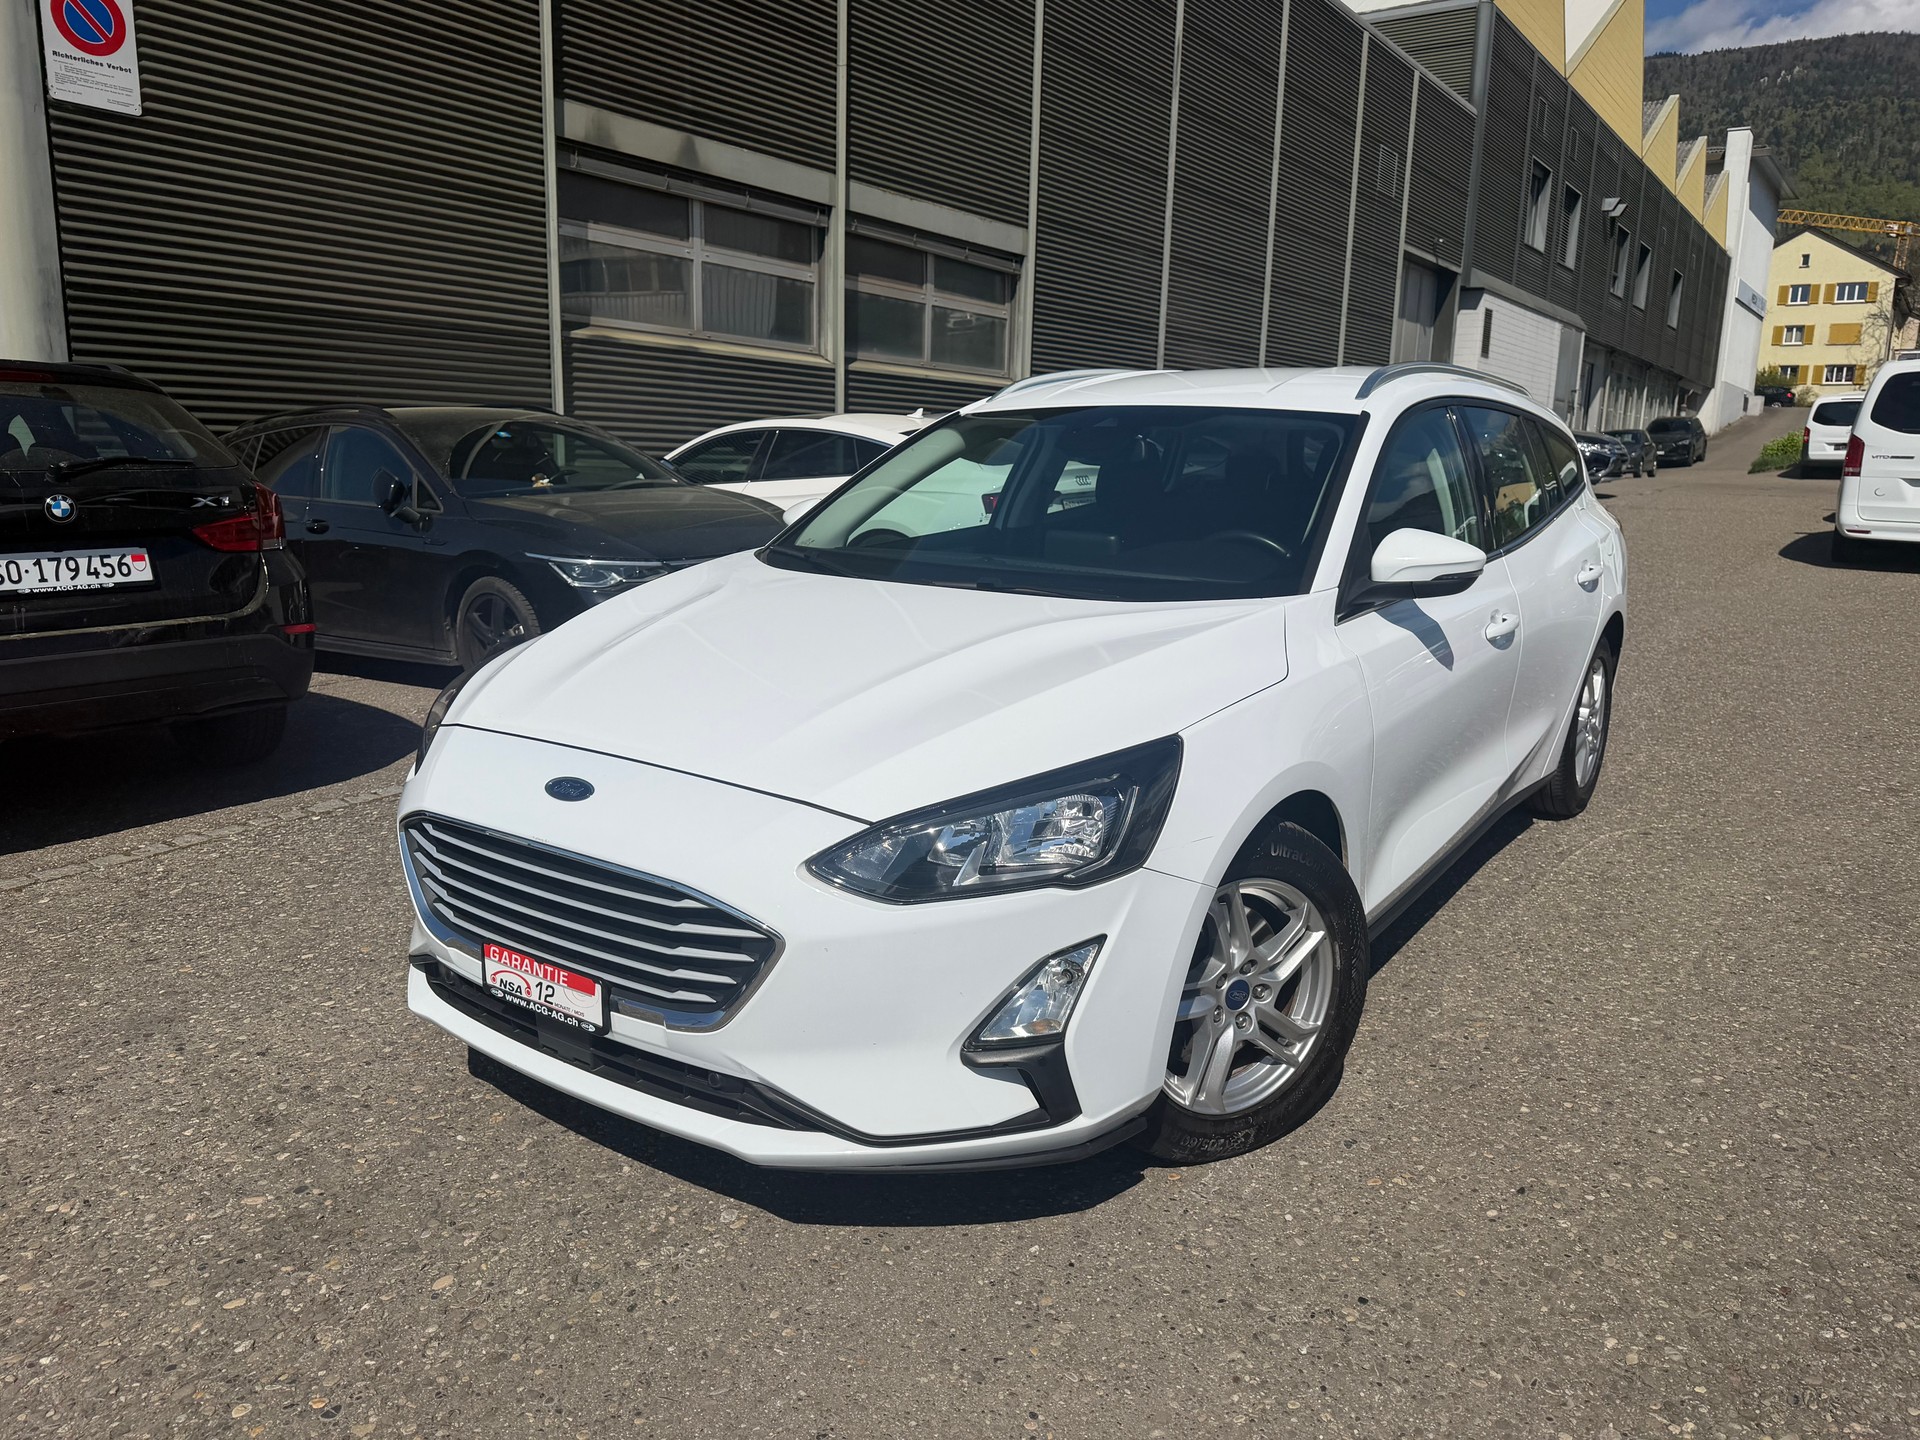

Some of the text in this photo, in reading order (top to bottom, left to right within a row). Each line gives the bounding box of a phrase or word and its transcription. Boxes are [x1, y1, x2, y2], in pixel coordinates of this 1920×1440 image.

[51, 50, 104, 67] Richterliches
[106, 62, 132, 74] Verbot
[32, 583, 101, 593] www.ACG-AG.ch
[489, 946, 569, 987] GARANTIE
[499, 978, 523, 996] NSA
[535, 981, 555, 1006] 12
[505, 993, 579, 1027] www.ACG-AG.ch
